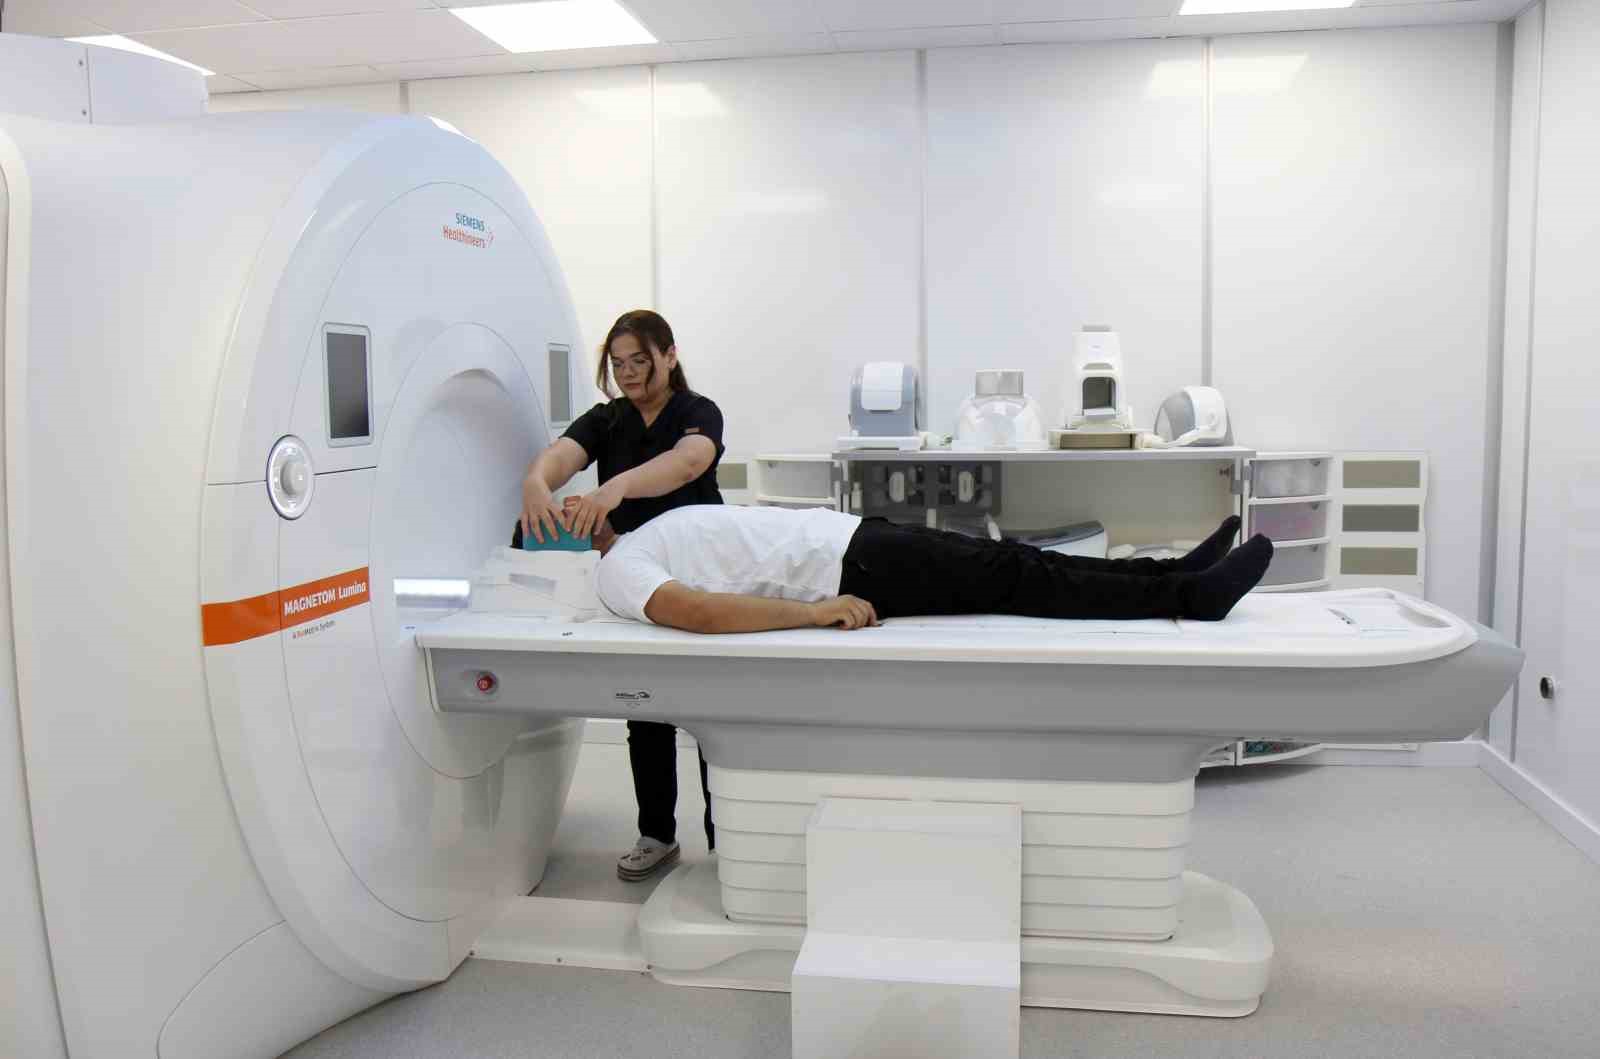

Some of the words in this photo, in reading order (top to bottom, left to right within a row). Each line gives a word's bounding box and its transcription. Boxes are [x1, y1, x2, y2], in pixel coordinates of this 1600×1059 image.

[455, 212, 485, 232] SIEMENS
[284, 588, 336, 616] MAGNETOM
[338, 581, 367, 599] Lumina
